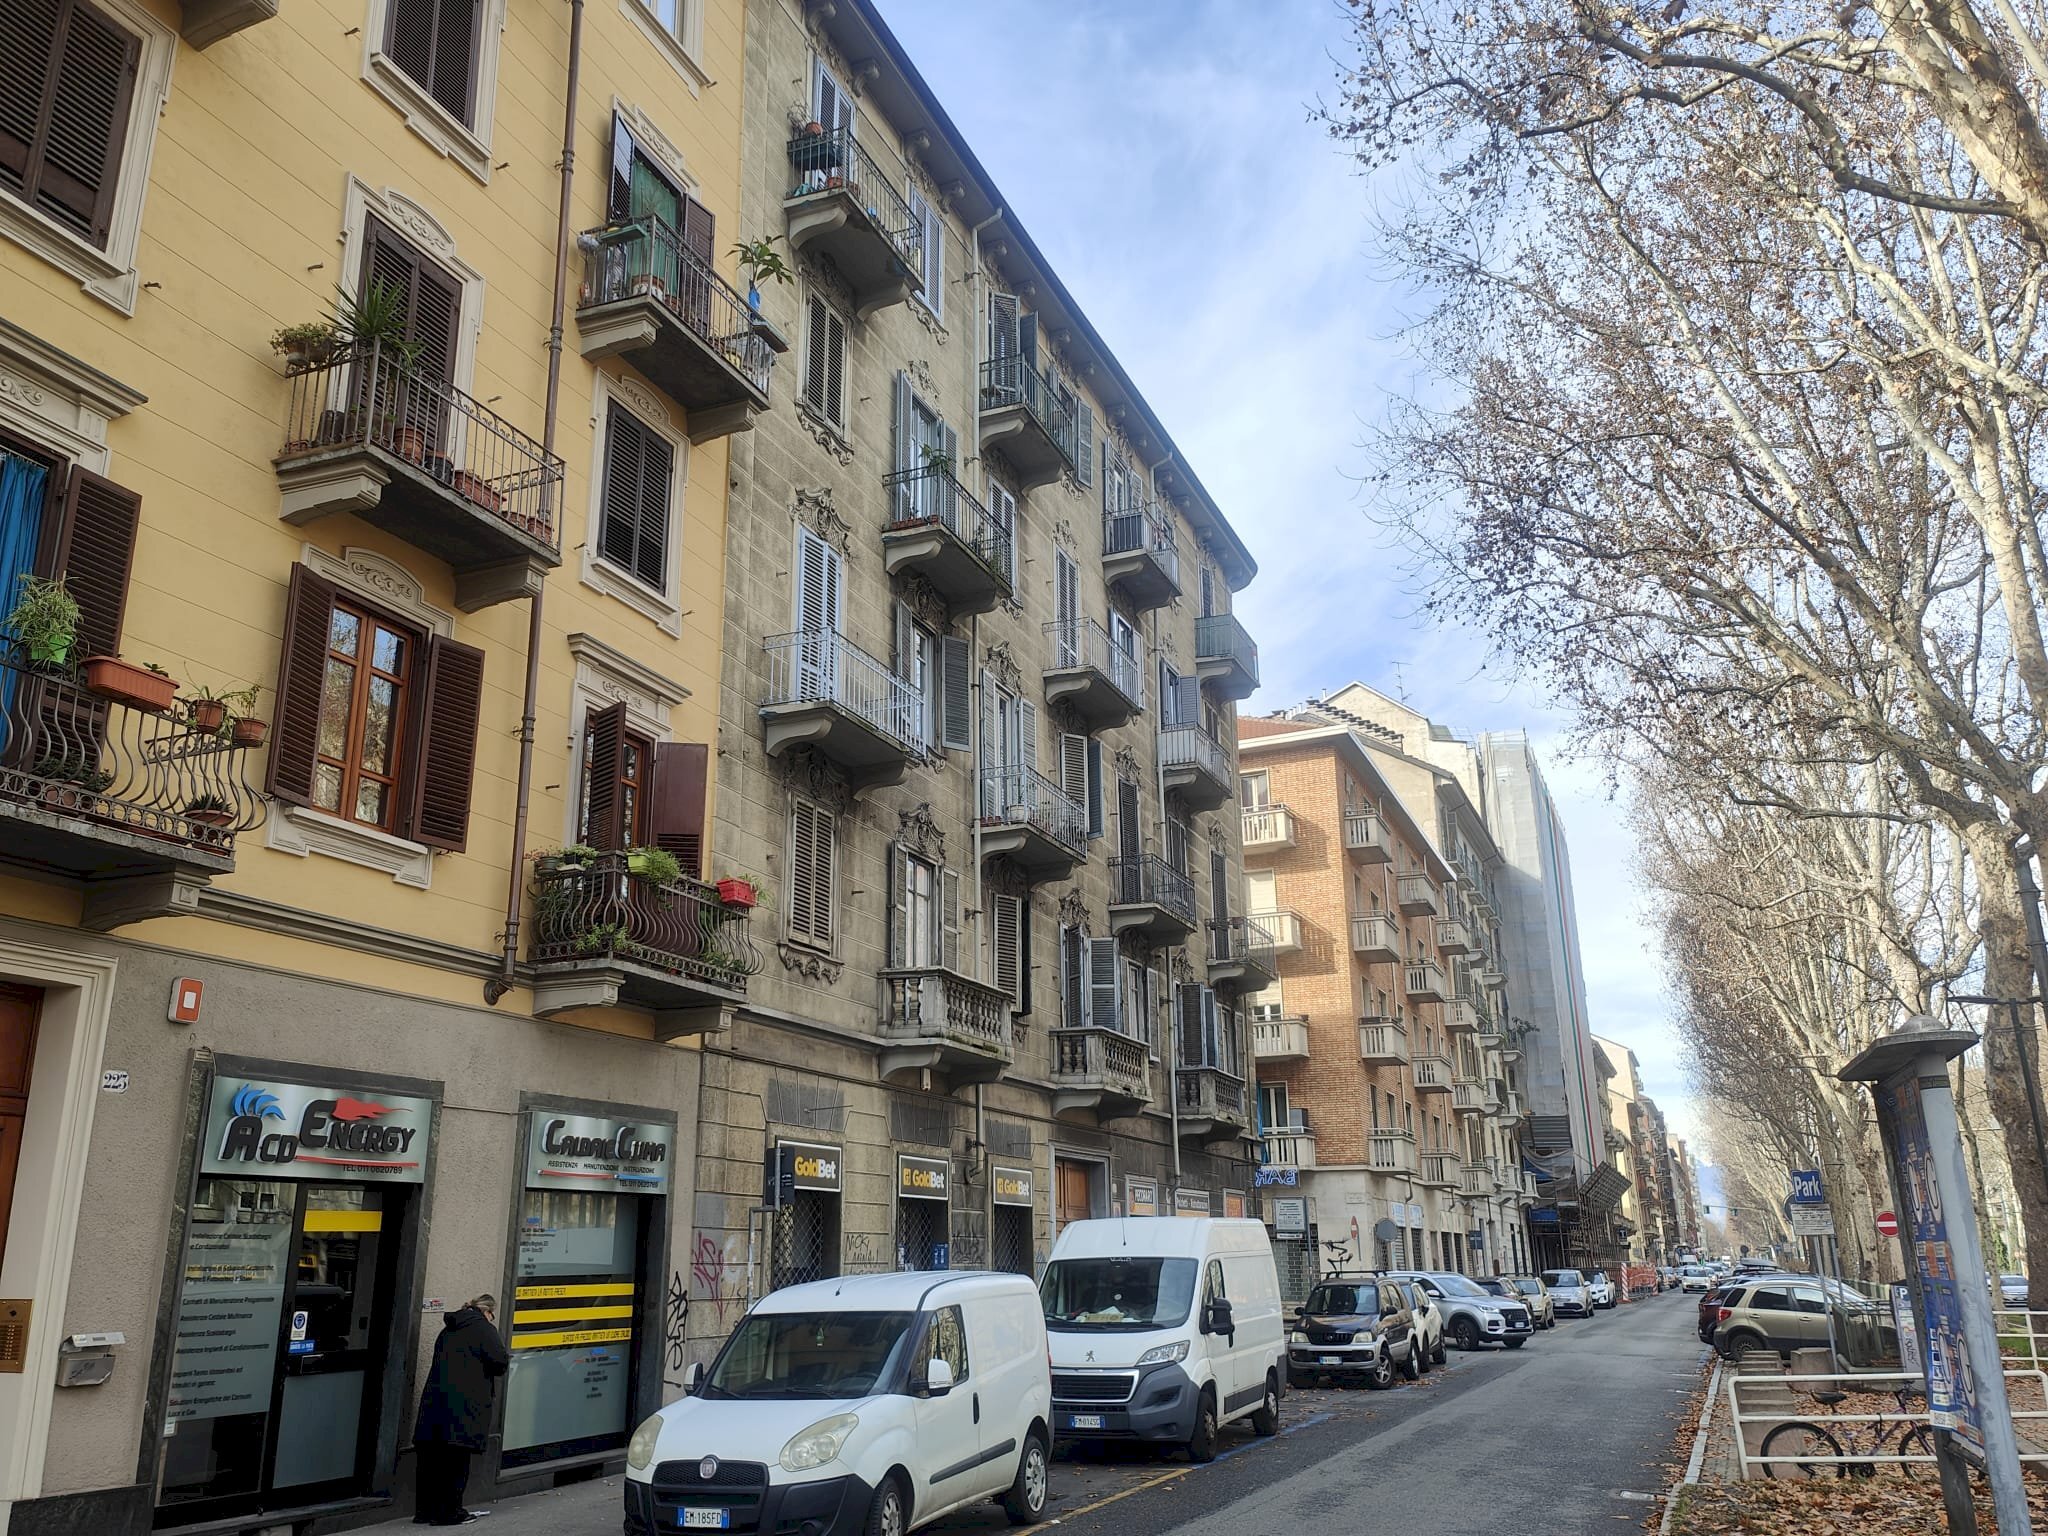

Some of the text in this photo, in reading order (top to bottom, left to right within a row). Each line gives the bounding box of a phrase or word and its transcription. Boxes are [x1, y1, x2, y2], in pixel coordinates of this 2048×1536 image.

[299, 1098, 417, 1154] ENERGY
[794, 1155, 836, 1180] GoldBet
[912, 1165, 945, 1189] GoldBet
[1004, 1178, 1030, 1197] GoldBet
[1793, 1175, 1822, 1197] Park
[1898, 1287, 1908, 1299] P
